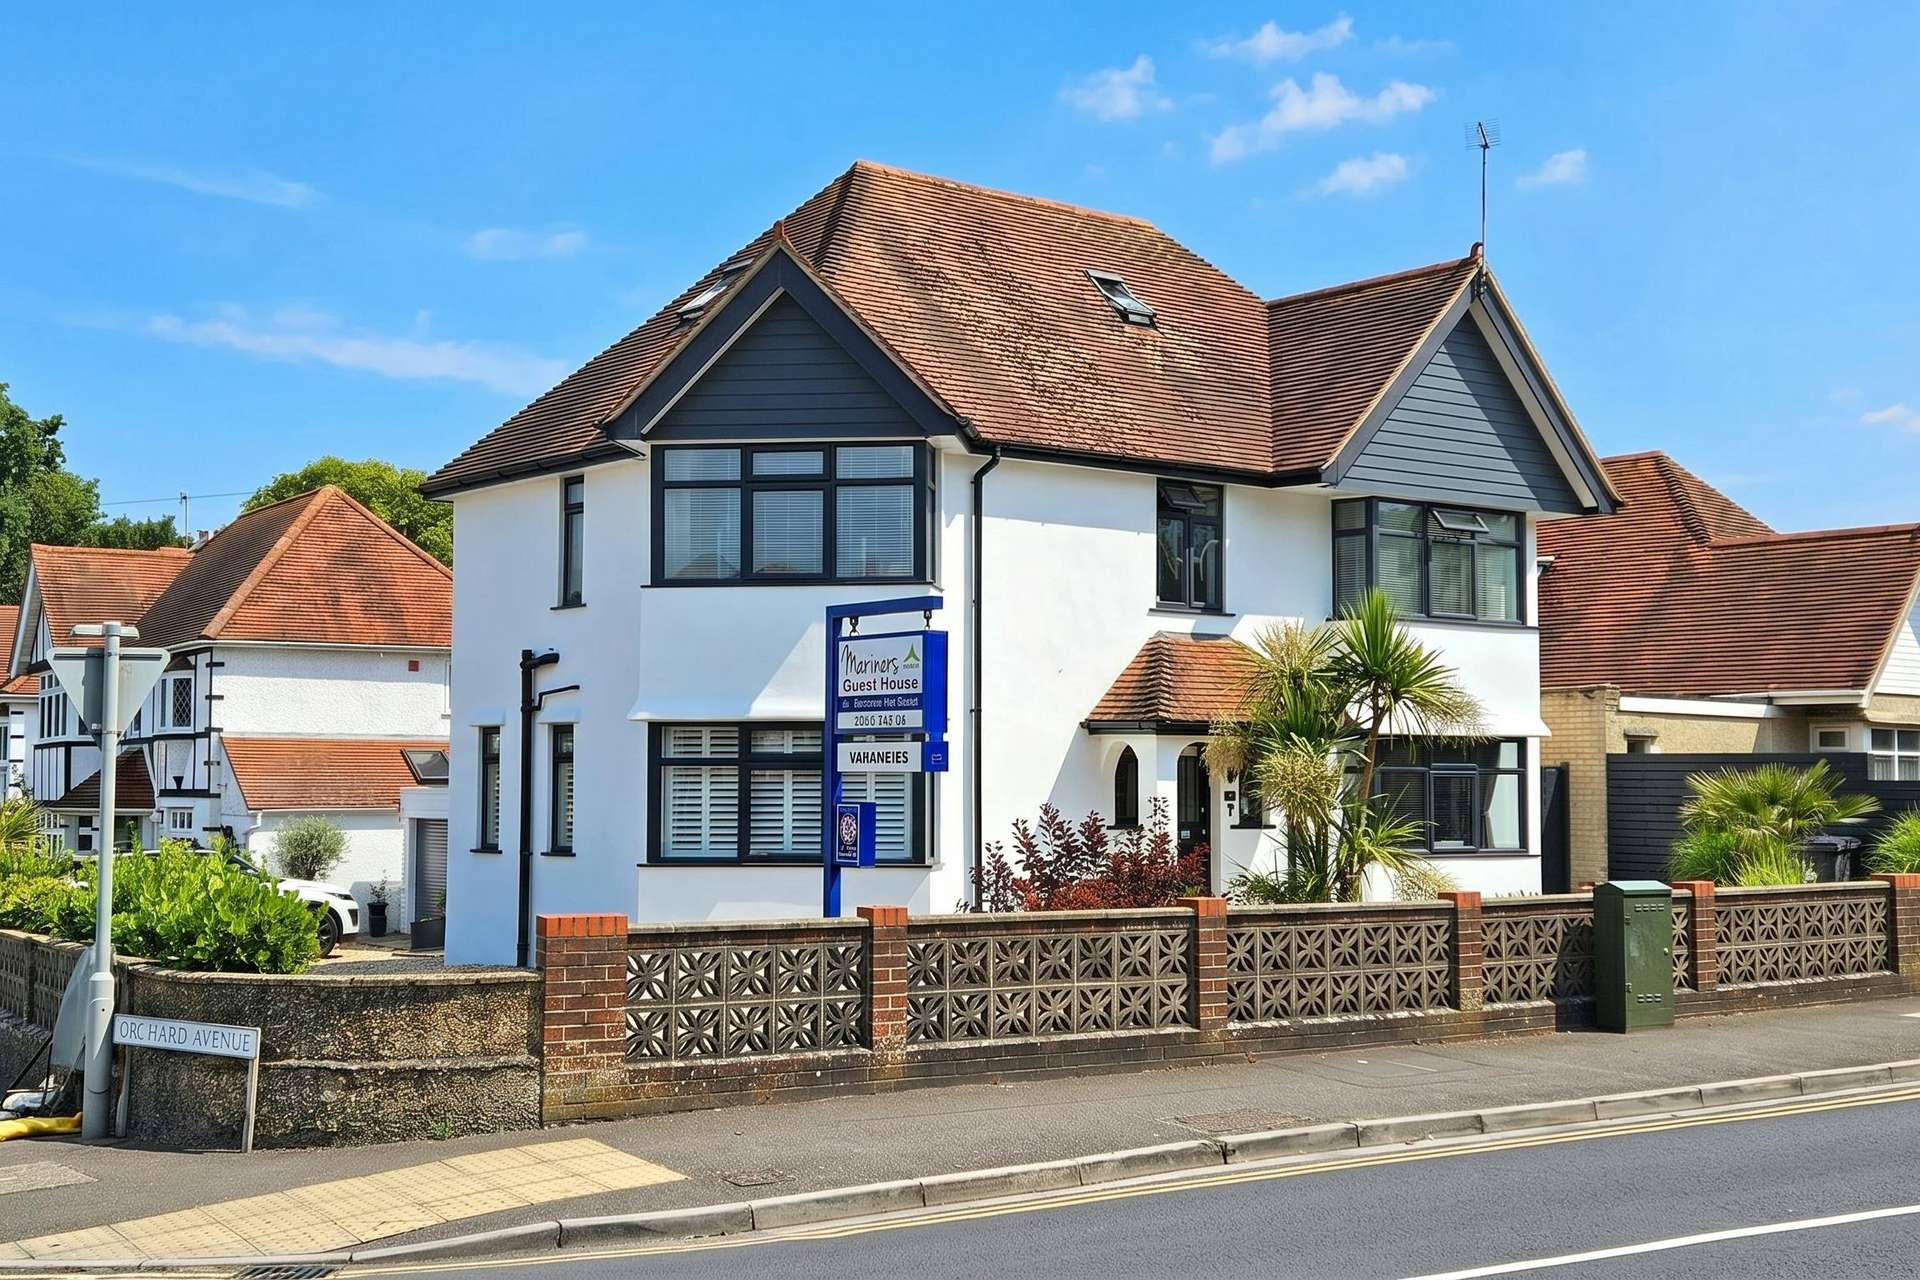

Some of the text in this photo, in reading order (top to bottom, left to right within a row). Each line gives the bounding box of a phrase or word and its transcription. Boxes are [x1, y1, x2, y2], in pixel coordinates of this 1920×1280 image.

[841, 644, 899, 676] Mariners
[843, 677, 918, 692] Guest House
[193, 1030, 250, 1052] AVENUE
